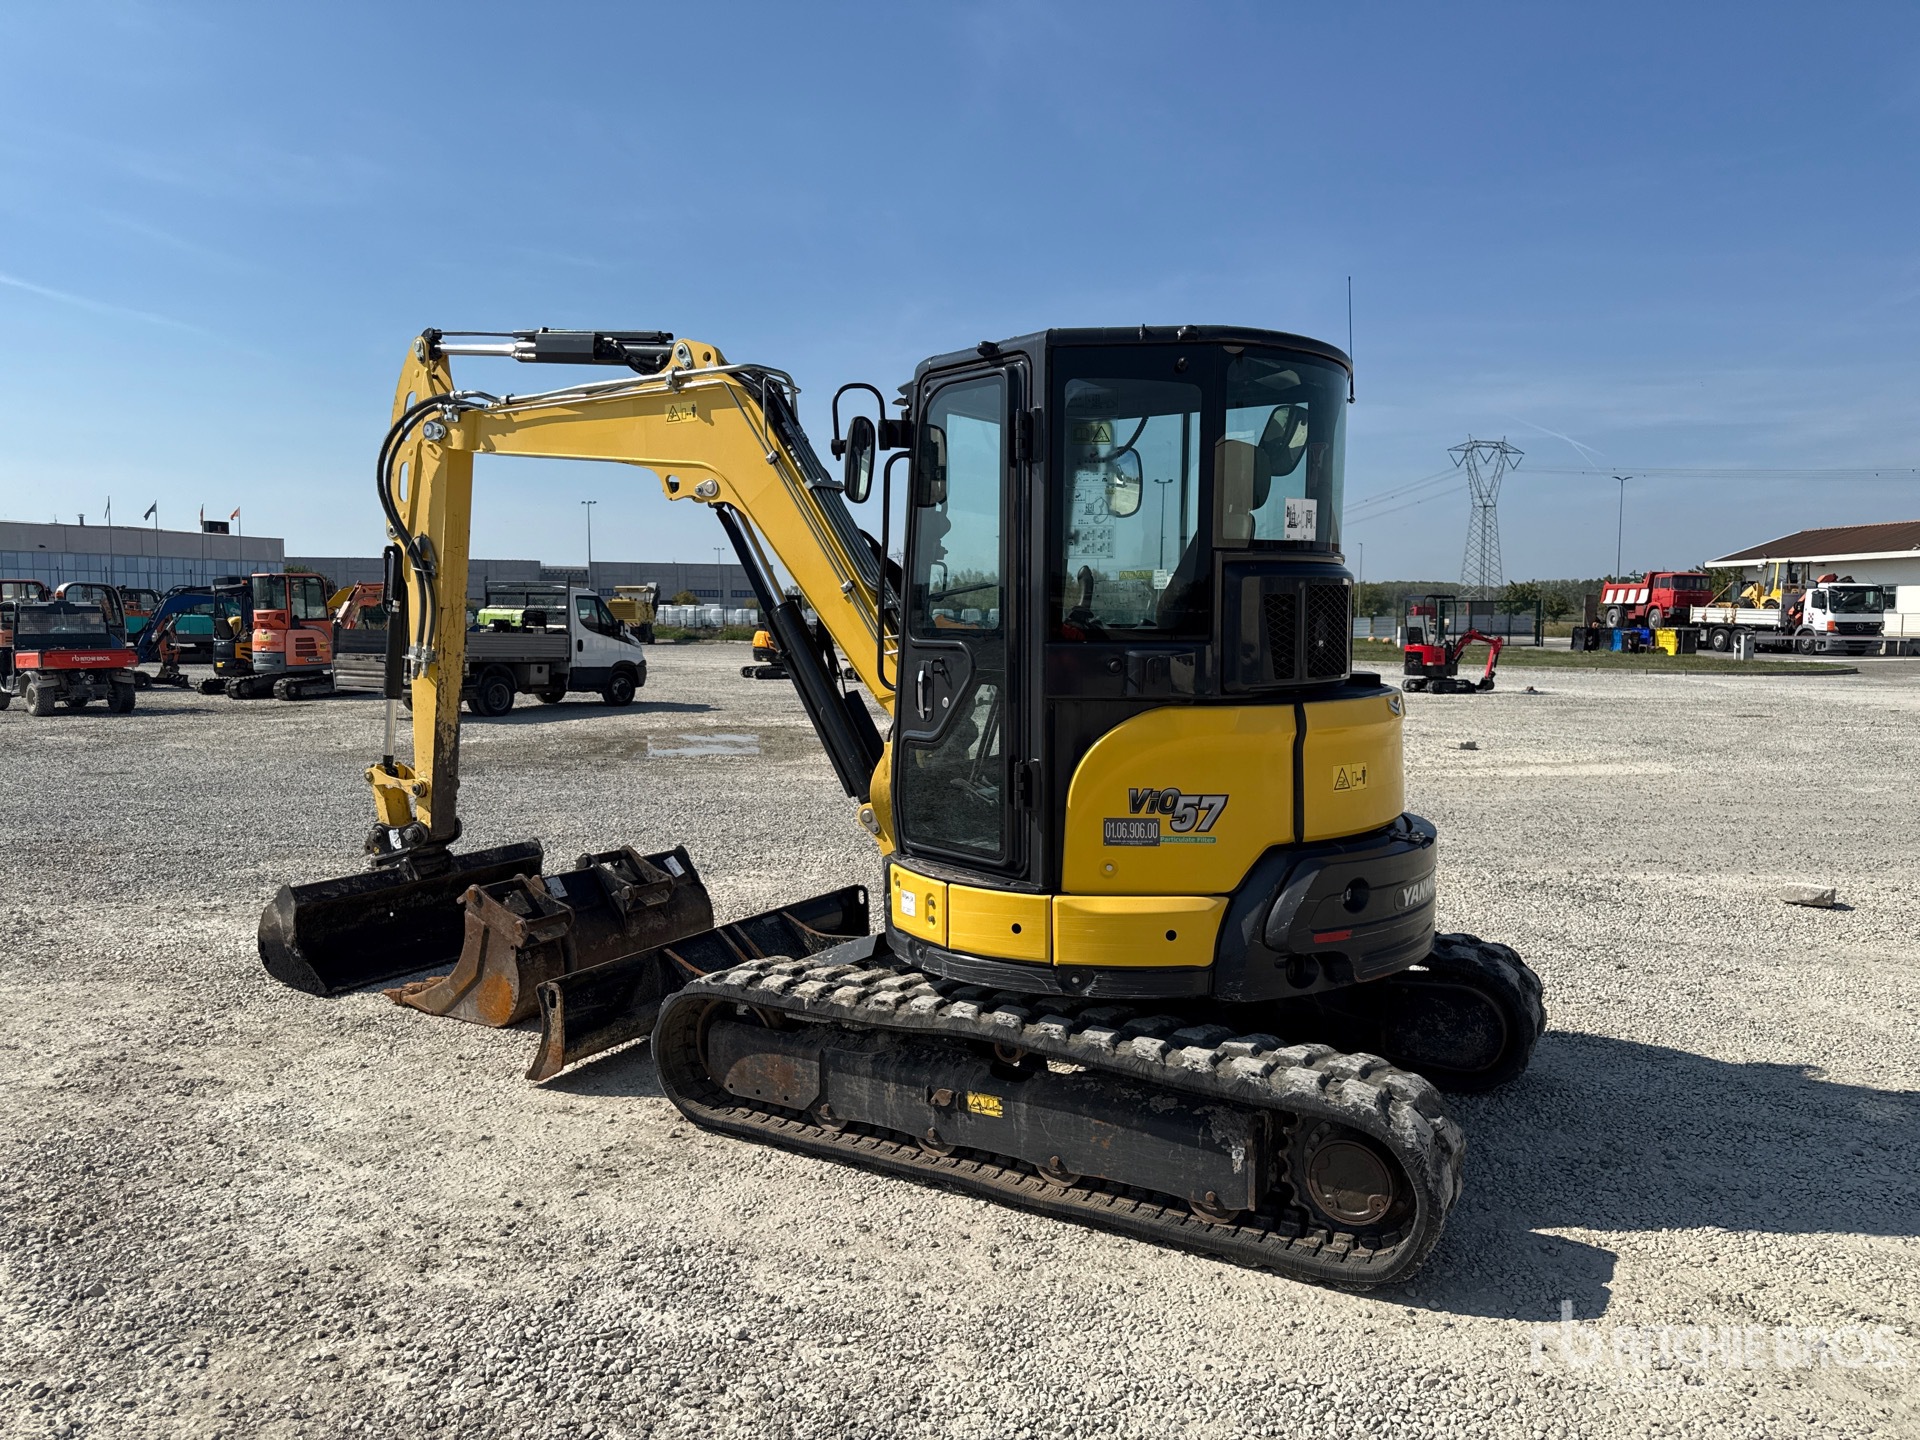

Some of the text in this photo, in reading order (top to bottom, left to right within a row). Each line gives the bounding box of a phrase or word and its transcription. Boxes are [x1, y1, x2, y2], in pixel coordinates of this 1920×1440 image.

[1105, 822, 1158, 839] 01.06.906.00
[1160, 835, 1195, 843] Particulate
[1403, 876, 1435, 907] YANM
